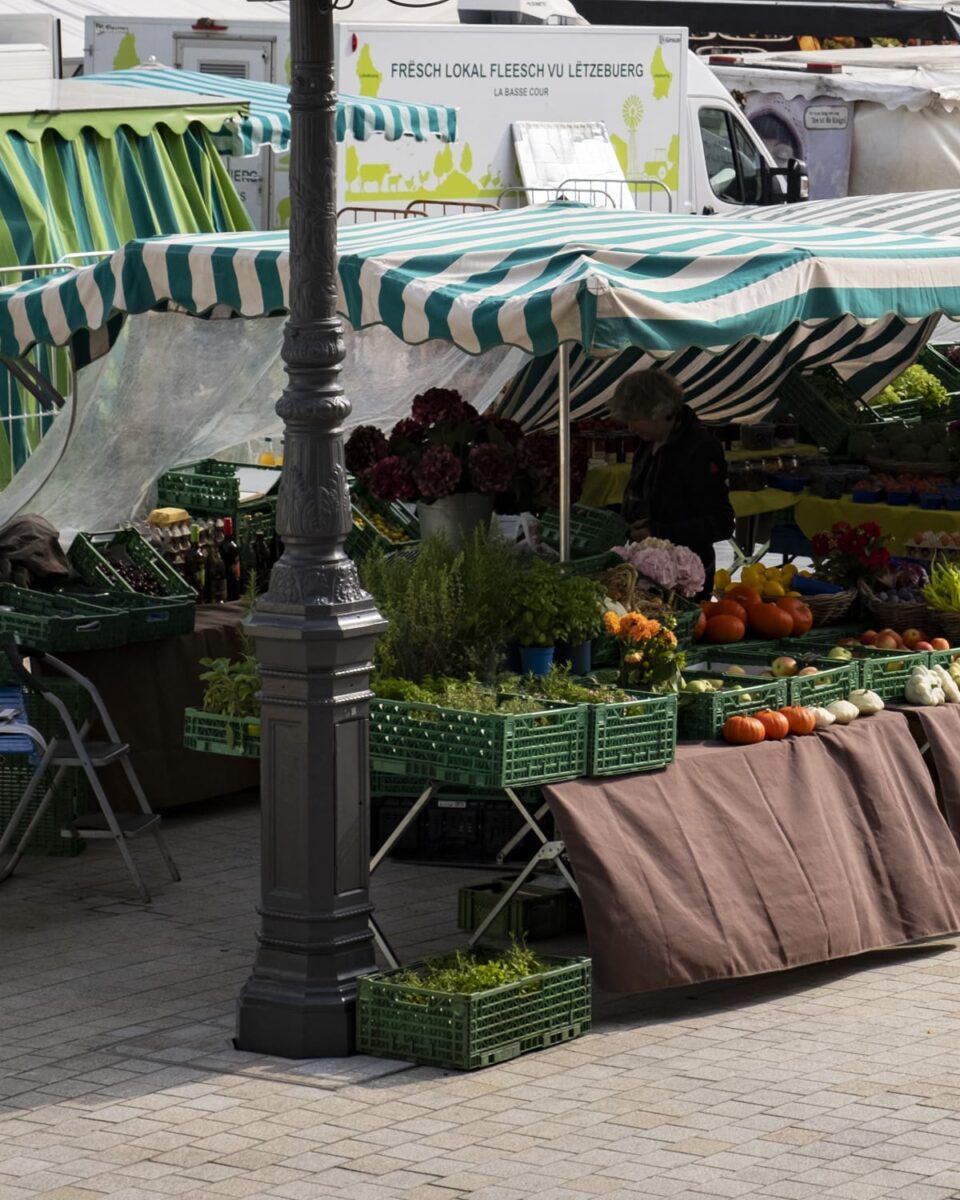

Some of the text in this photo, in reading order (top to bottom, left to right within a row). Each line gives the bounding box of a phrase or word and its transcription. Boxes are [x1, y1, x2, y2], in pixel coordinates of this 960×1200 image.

[391, 60, 644, 78] FRËSCH LOKAL FLEESCH VU LËTZEBUERG
[494, 87, 549, 97] LA BASSE COUR
